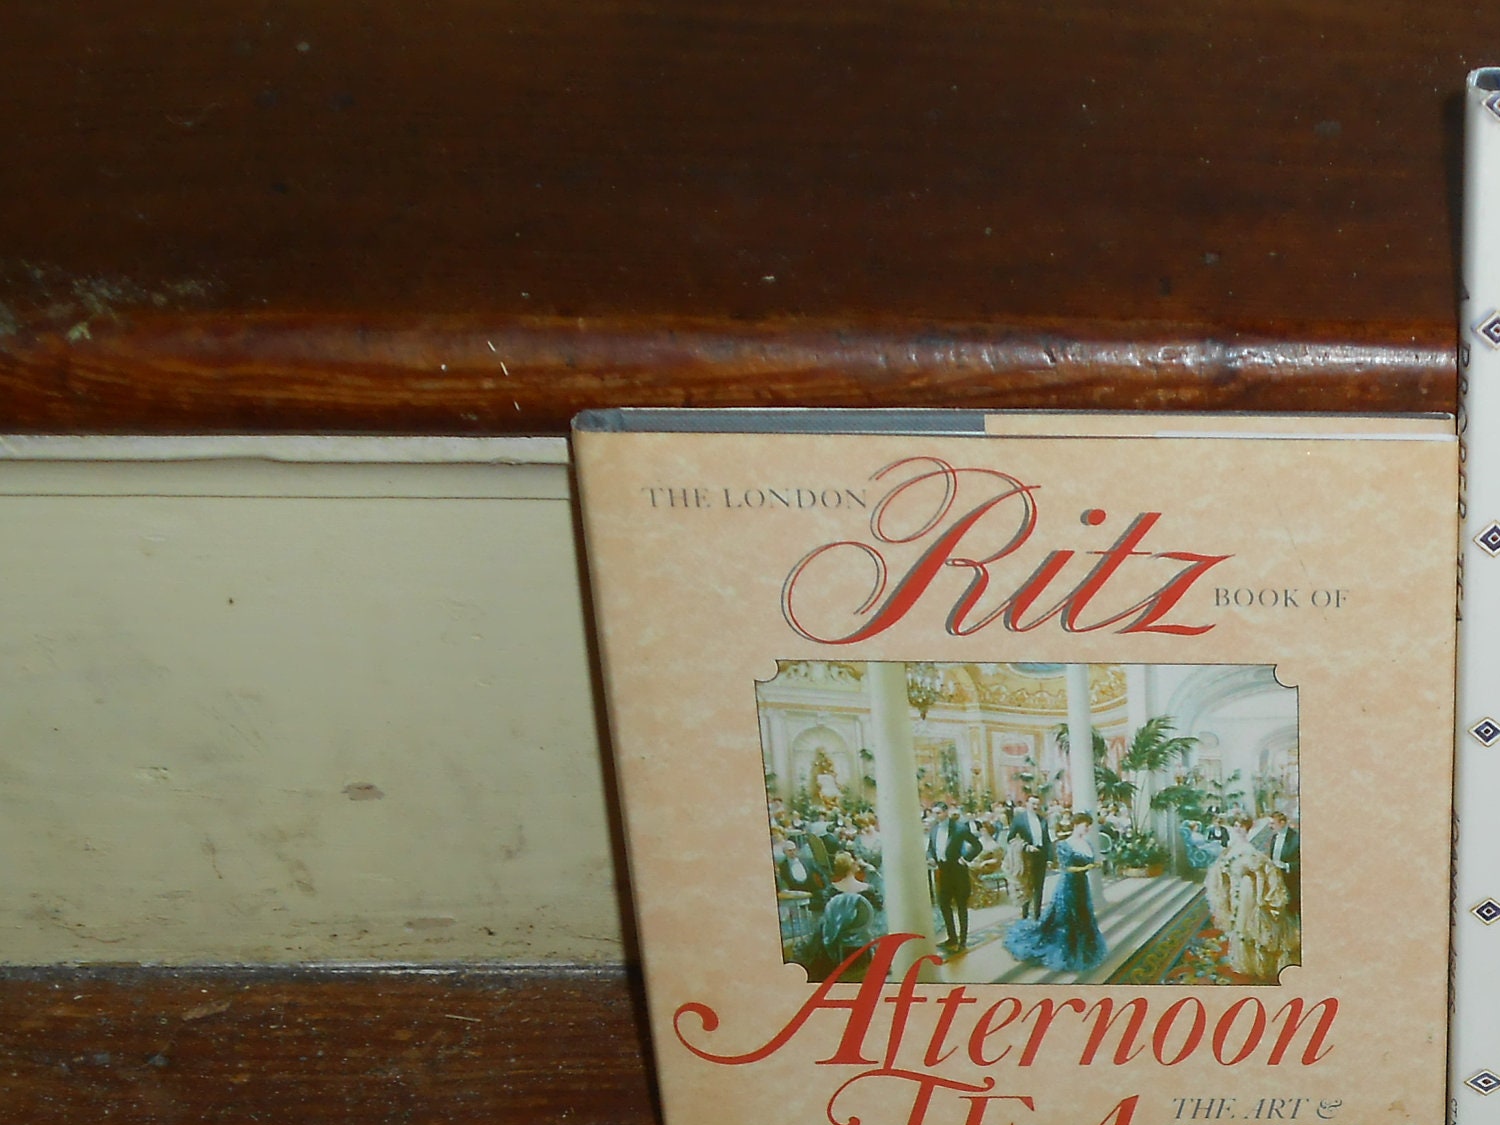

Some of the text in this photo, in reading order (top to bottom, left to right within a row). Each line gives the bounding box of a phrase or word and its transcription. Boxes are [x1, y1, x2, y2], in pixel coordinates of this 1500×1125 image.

[642, 486, 870, 511] THE LONDON
[780, 456, 1237, 645] Ritz
[1213, 586, 1350, 609] BOOK OF
[672, 932, 1341, 1072] Afternoon
[1172, 1098, 1343, 1120] THE ART &
